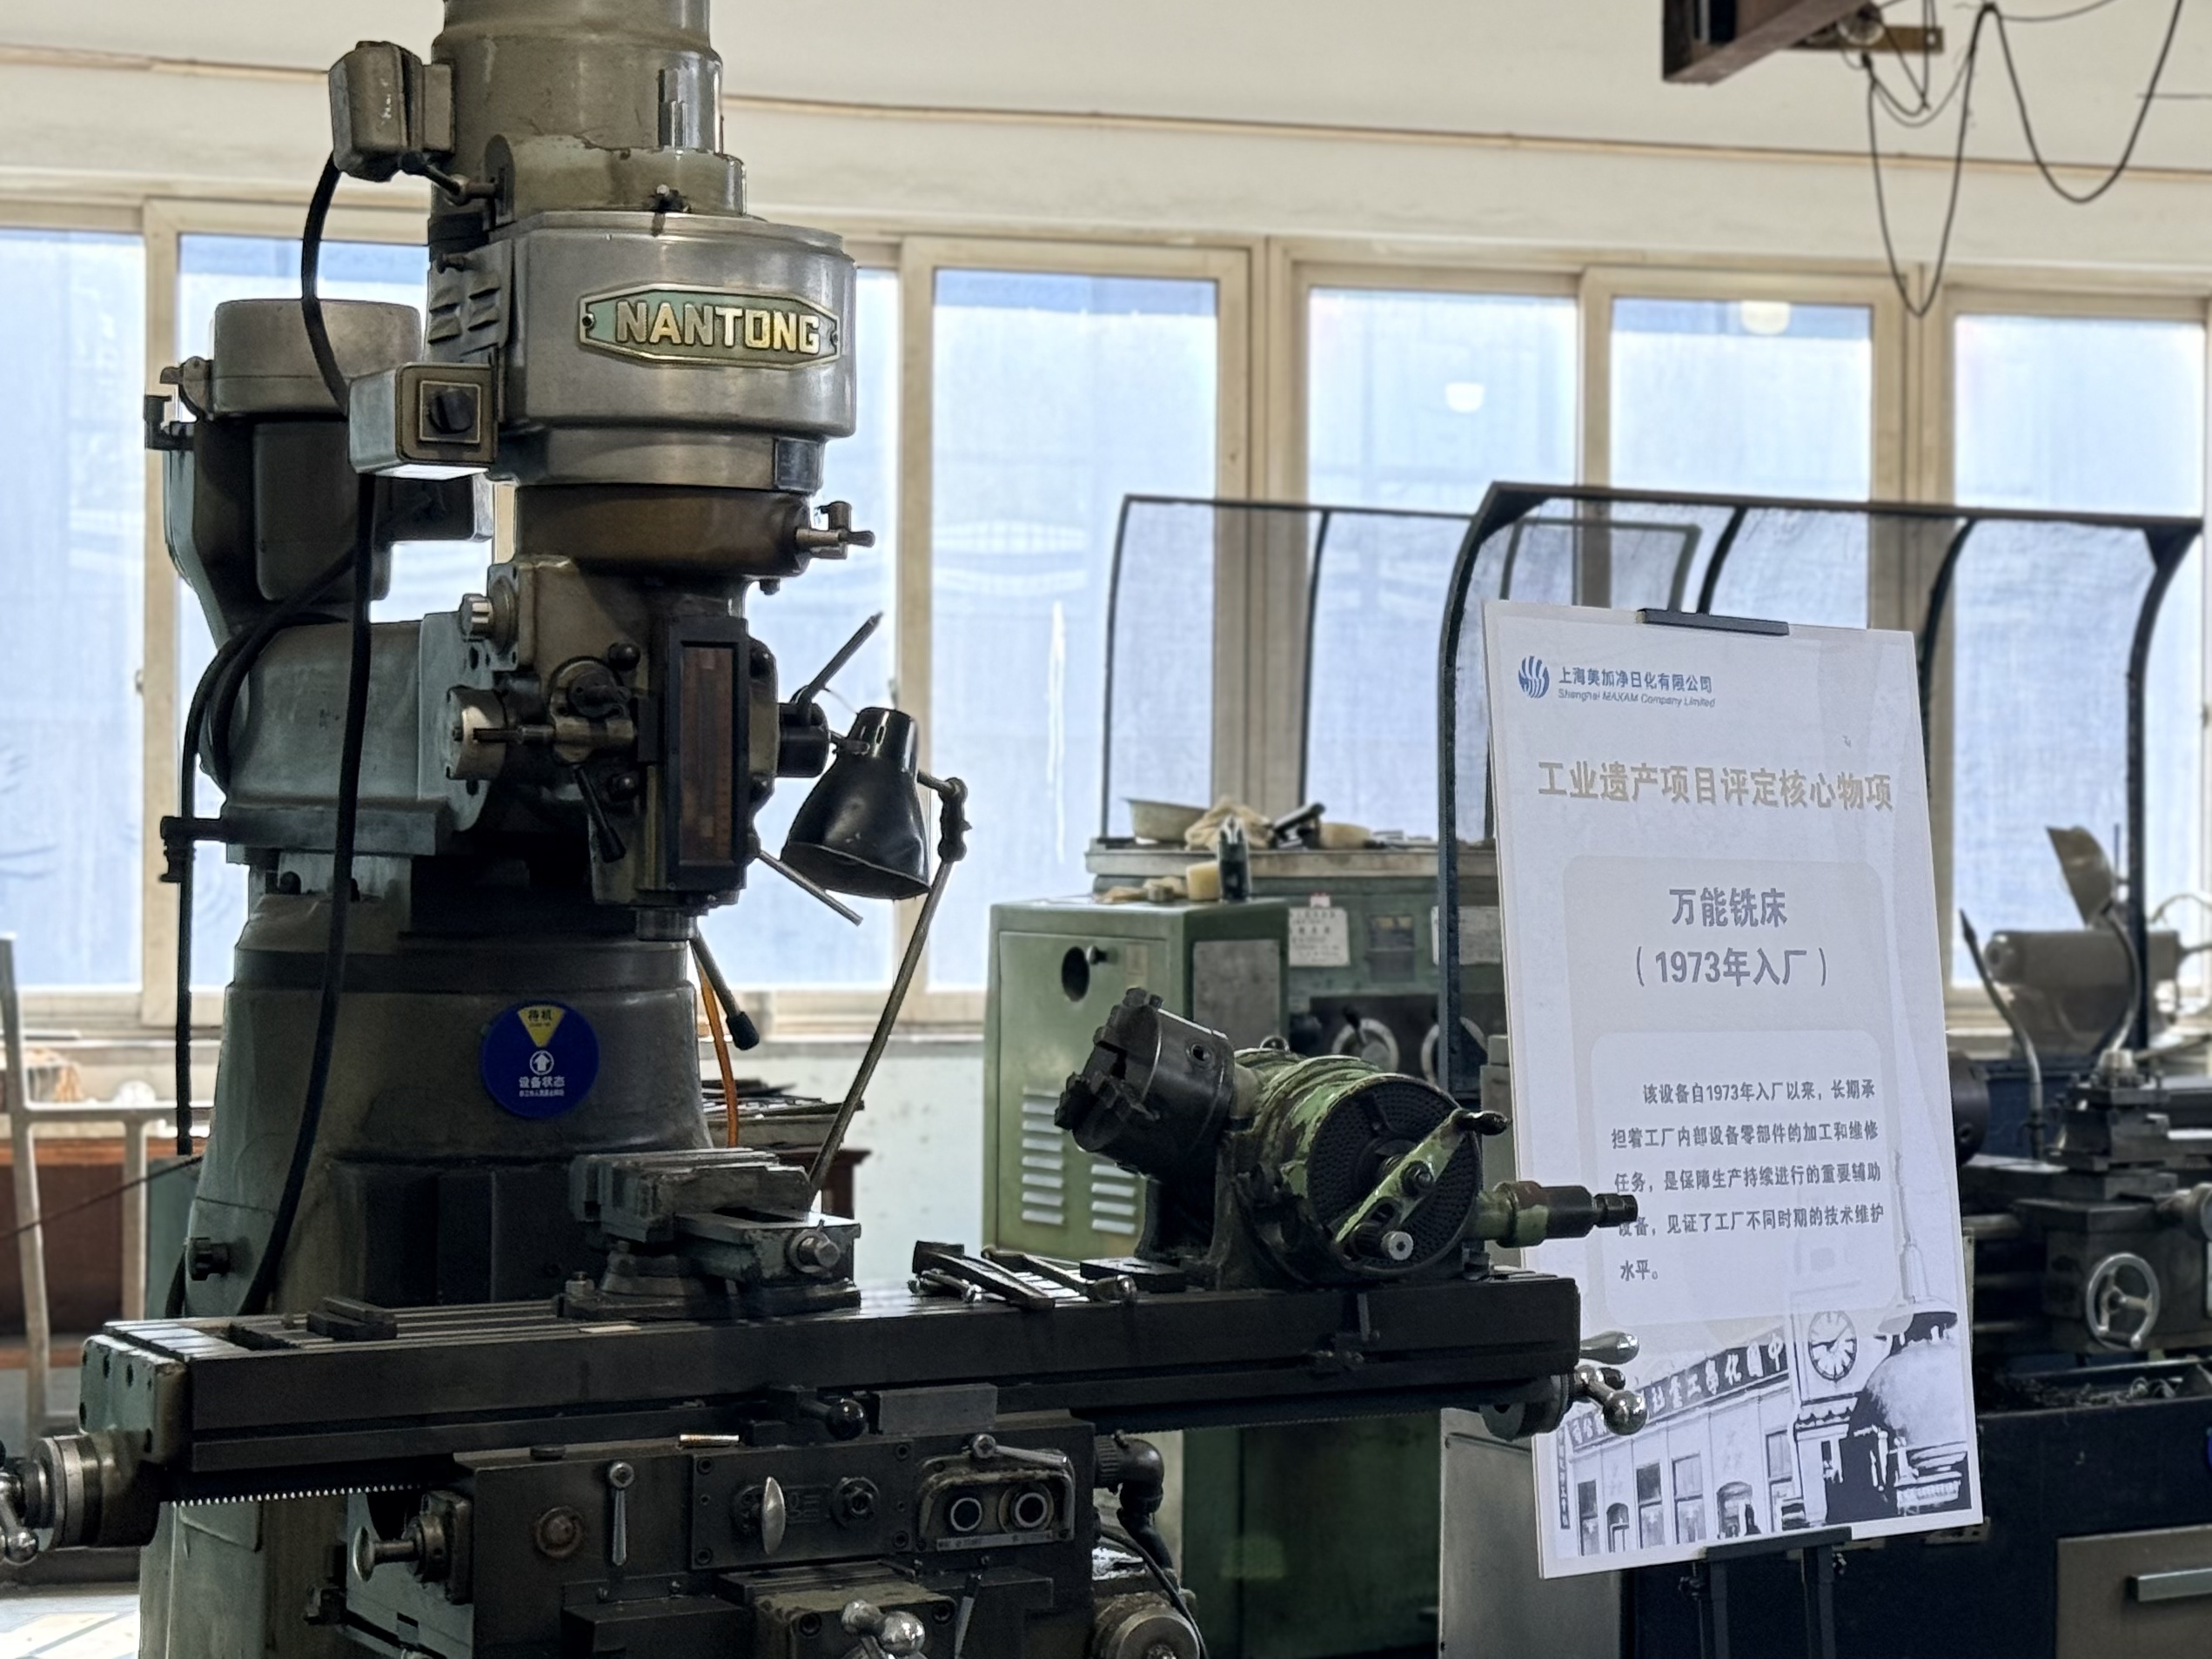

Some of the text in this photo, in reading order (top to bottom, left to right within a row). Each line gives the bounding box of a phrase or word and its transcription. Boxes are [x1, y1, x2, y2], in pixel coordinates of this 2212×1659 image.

[616, 300, 821, 354] NANTONG
[1558, 666, 1713, 694] 上海美加净日化有限公司
[1641, 693, 1682, 708] Company
[1538, 760, 1894, 812] 工业遗产项目评定核心物项
[1669, 887, 1788, 928] 万能铣床
[519, 1076, 566, 1089] 设备状态
[1612, 1119, 1880, 1150] 担着工厂内部设备零部件的加工和维修
[1619, 1259, 1659, 1281] 水平。
